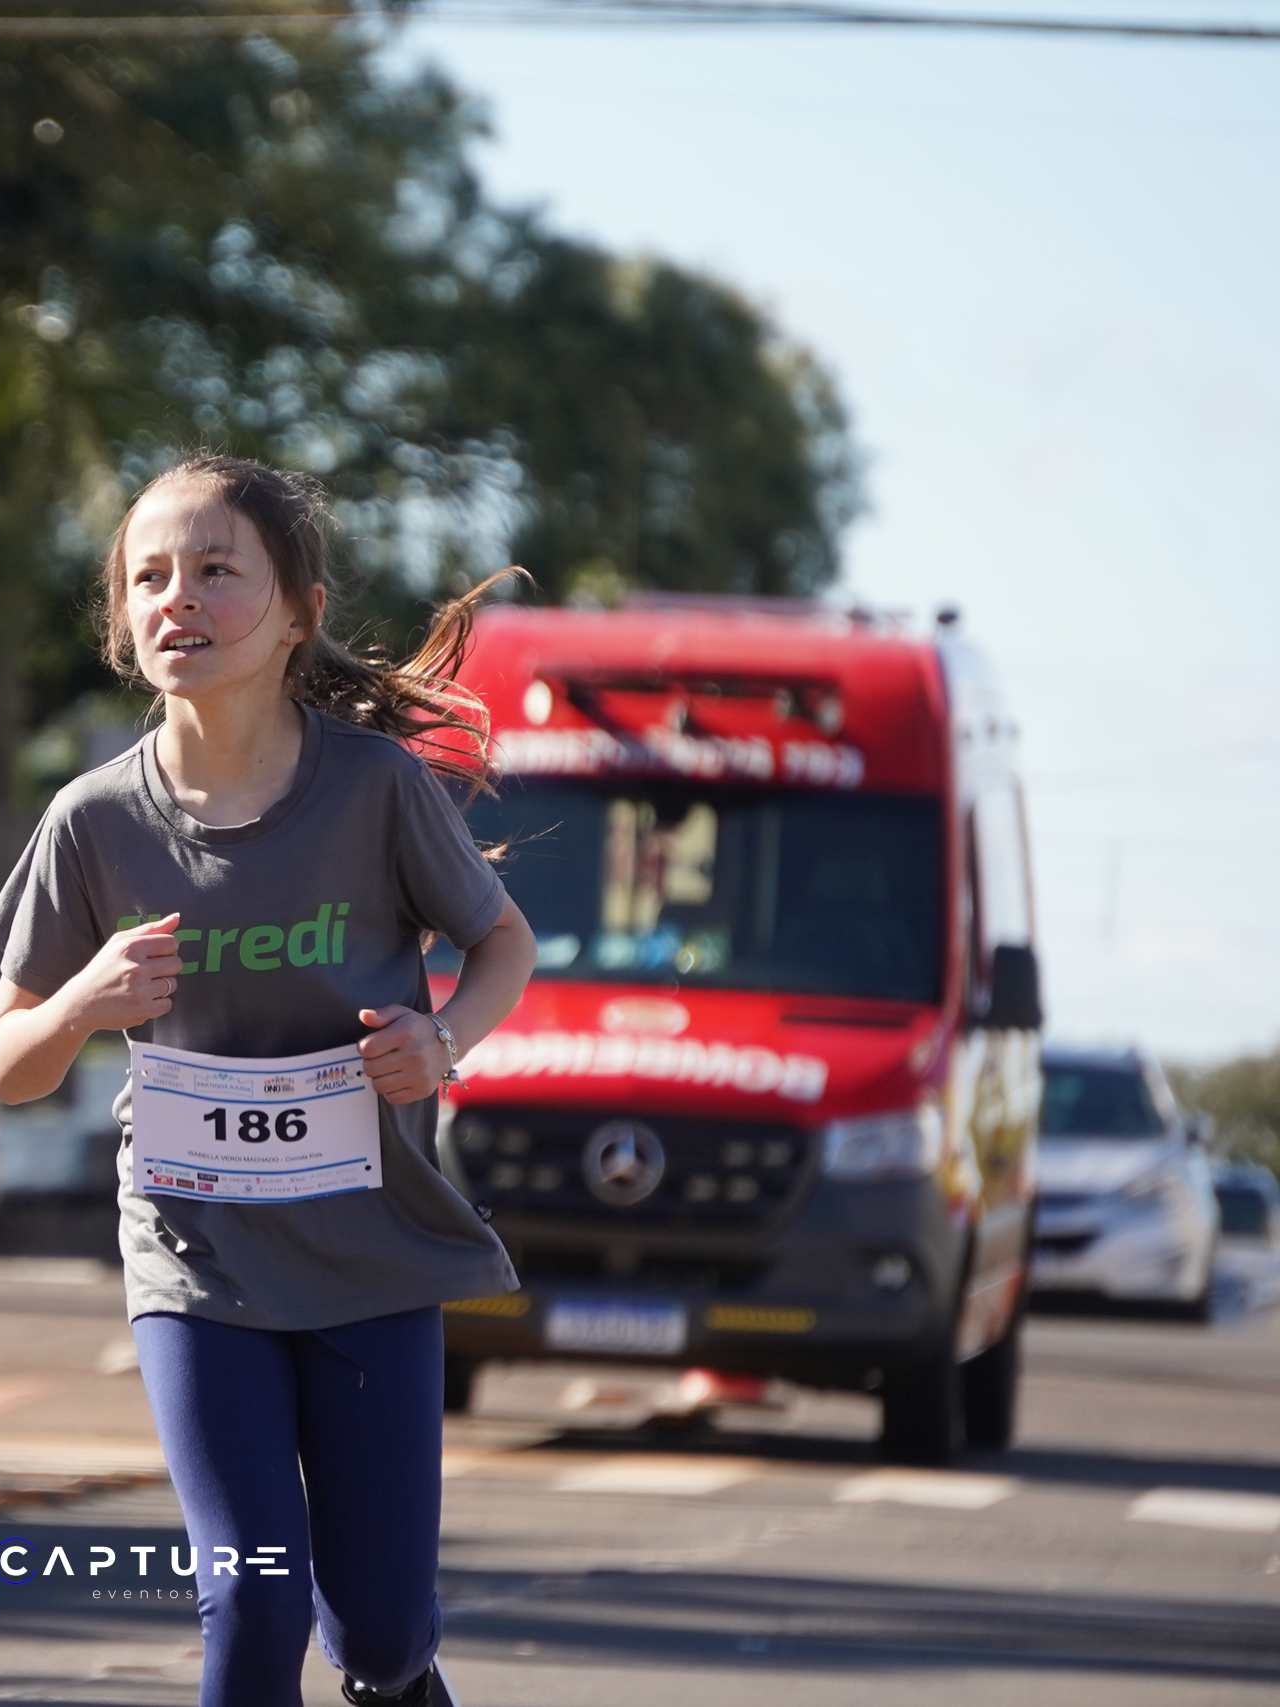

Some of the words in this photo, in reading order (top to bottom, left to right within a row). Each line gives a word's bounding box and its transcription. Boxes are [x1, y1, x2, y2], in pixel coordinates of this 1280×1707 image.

[116, 902, 351, 975] credi
[196, 1081, 228, 1090] PRATIQUE
[229, 1084, 251, 1093] AJUDA
[315, 1079, 348, 1093] CAUSA
[203, 1107, 308, 1143] 186
[187, 1150, 220, 1161] ISABELLA
[285, 1154, 308, 1163] Corrida
[309, 1152, 323, 1160] Kids
[164, 1167, 191, 1178] Sicredi
